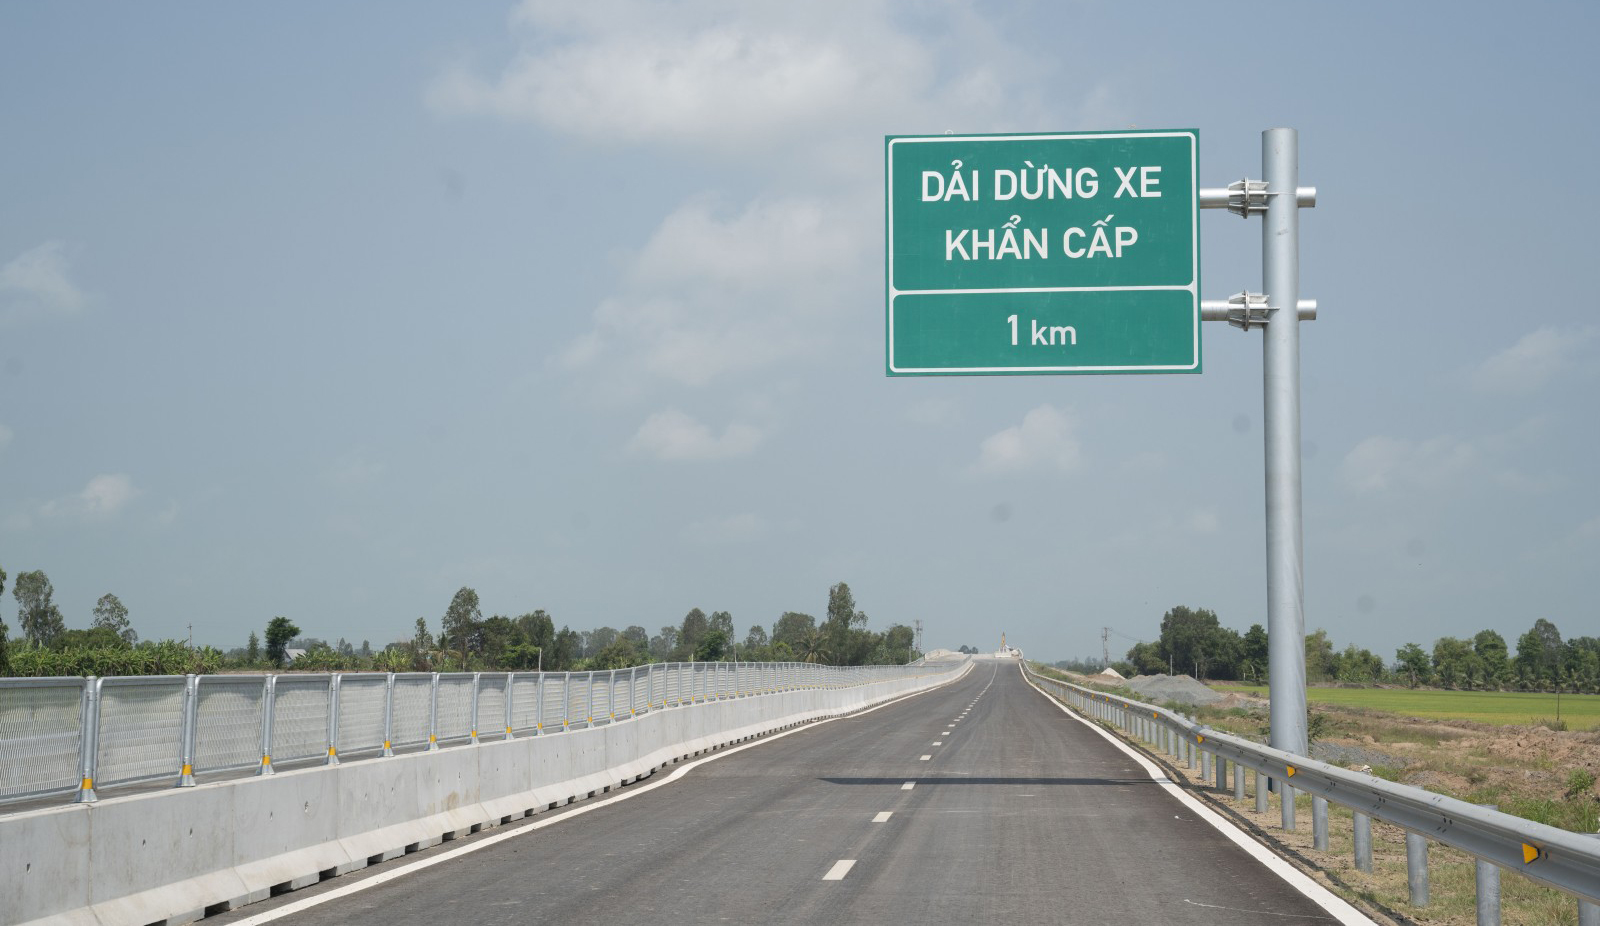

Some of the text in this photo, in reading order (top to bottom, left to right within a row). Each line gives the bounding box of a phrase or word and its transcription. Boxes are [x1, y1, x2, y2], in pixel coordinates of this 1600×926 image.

[921, 159, 1162, 202] DẢI DỪNG XE
[945, 214, 1139, 261] KHẨN CẤP
[1007, 314, 1077, 346] 1 km
